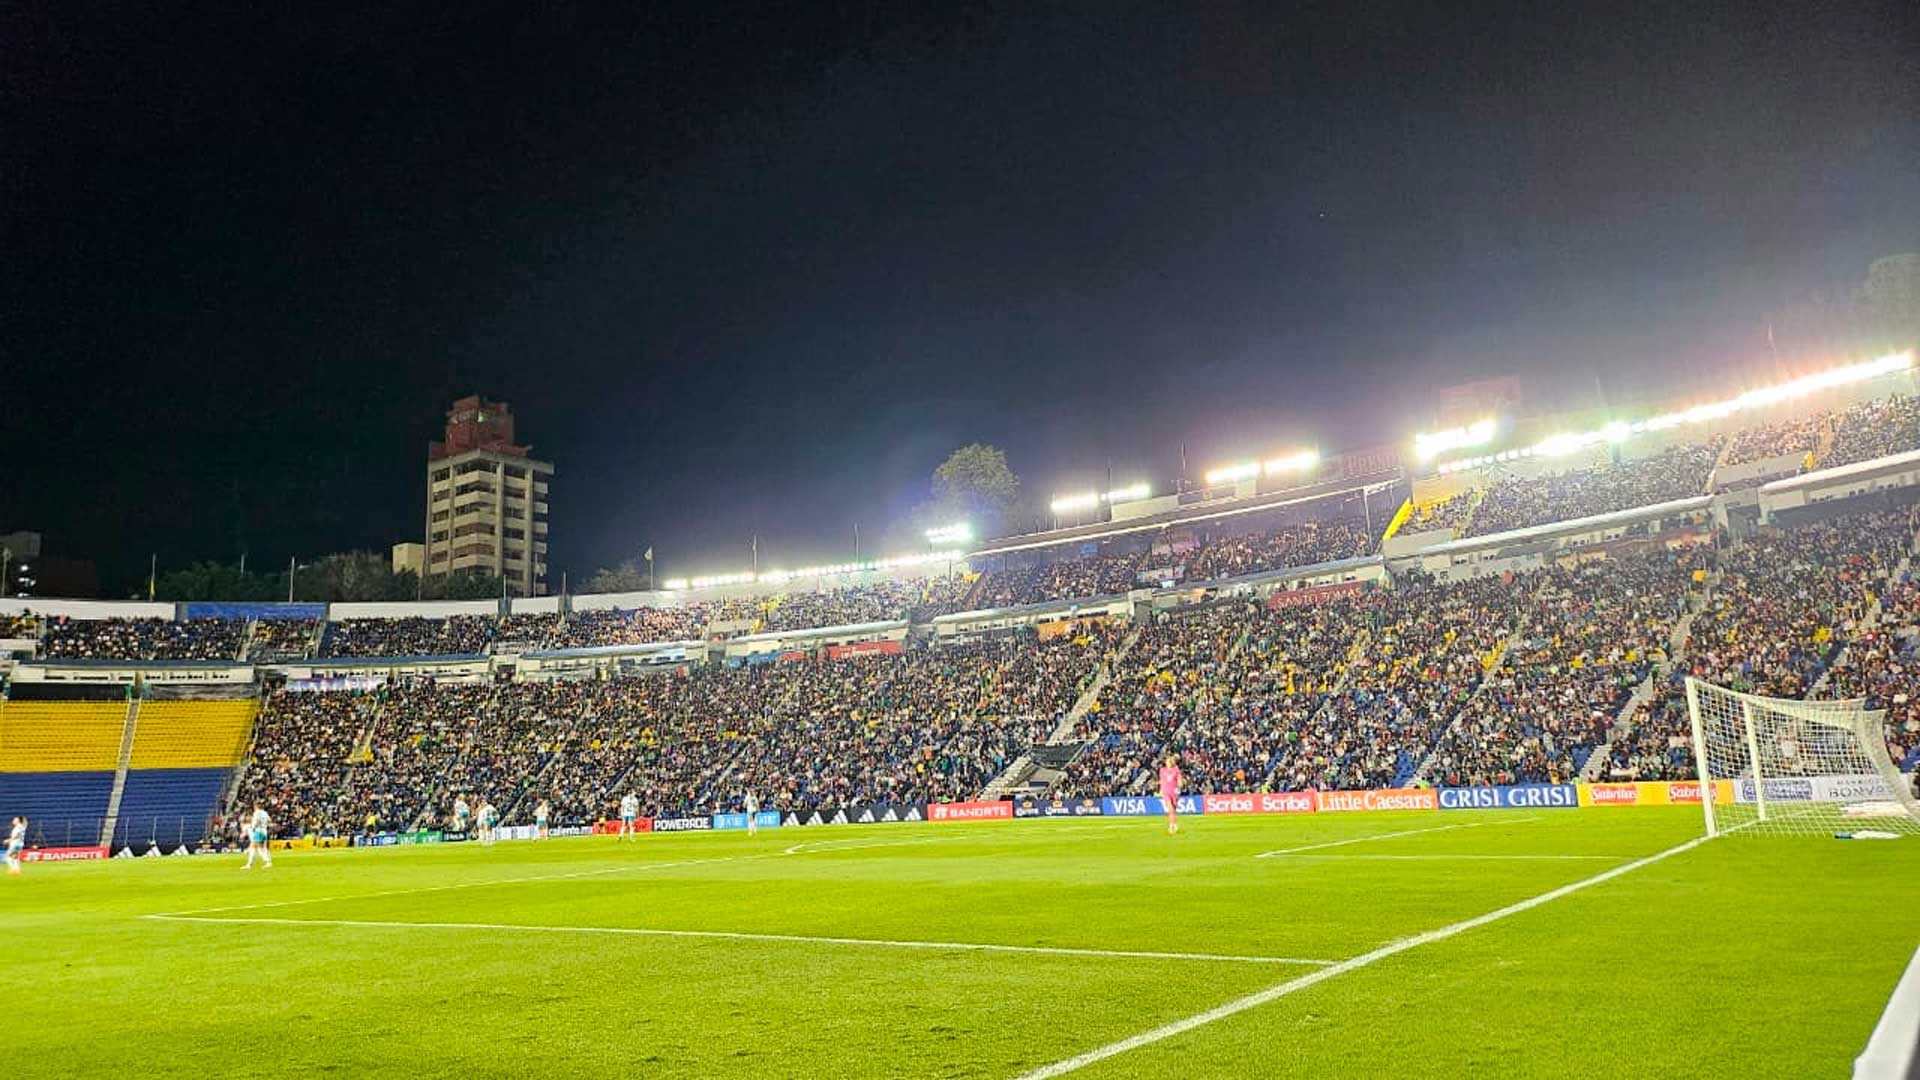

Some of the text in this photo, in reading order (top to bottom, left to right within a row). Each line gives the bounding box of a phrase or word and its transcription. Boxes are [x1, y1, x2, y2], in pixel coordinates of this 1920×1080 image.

[1439, 789, 1501, 807] GRISI
[1507, 786, 1571, 806] GRISI
[1592, 785, 1637, 799] Sabritas
[1112, 799, 1147, 813] VISA
[1159, 798, 1196, 813] VSA
[1207, 798, 1253, 812] Scribe
[1262, 796, 1310, 811] Scribe
[1316, 792, 1433, 811] Little Caesars
[950, 806, 1008, 817] BANORTE
[653, 816, 711, 831] POWERADE
[43, 850, 105, 860] BANORTE
